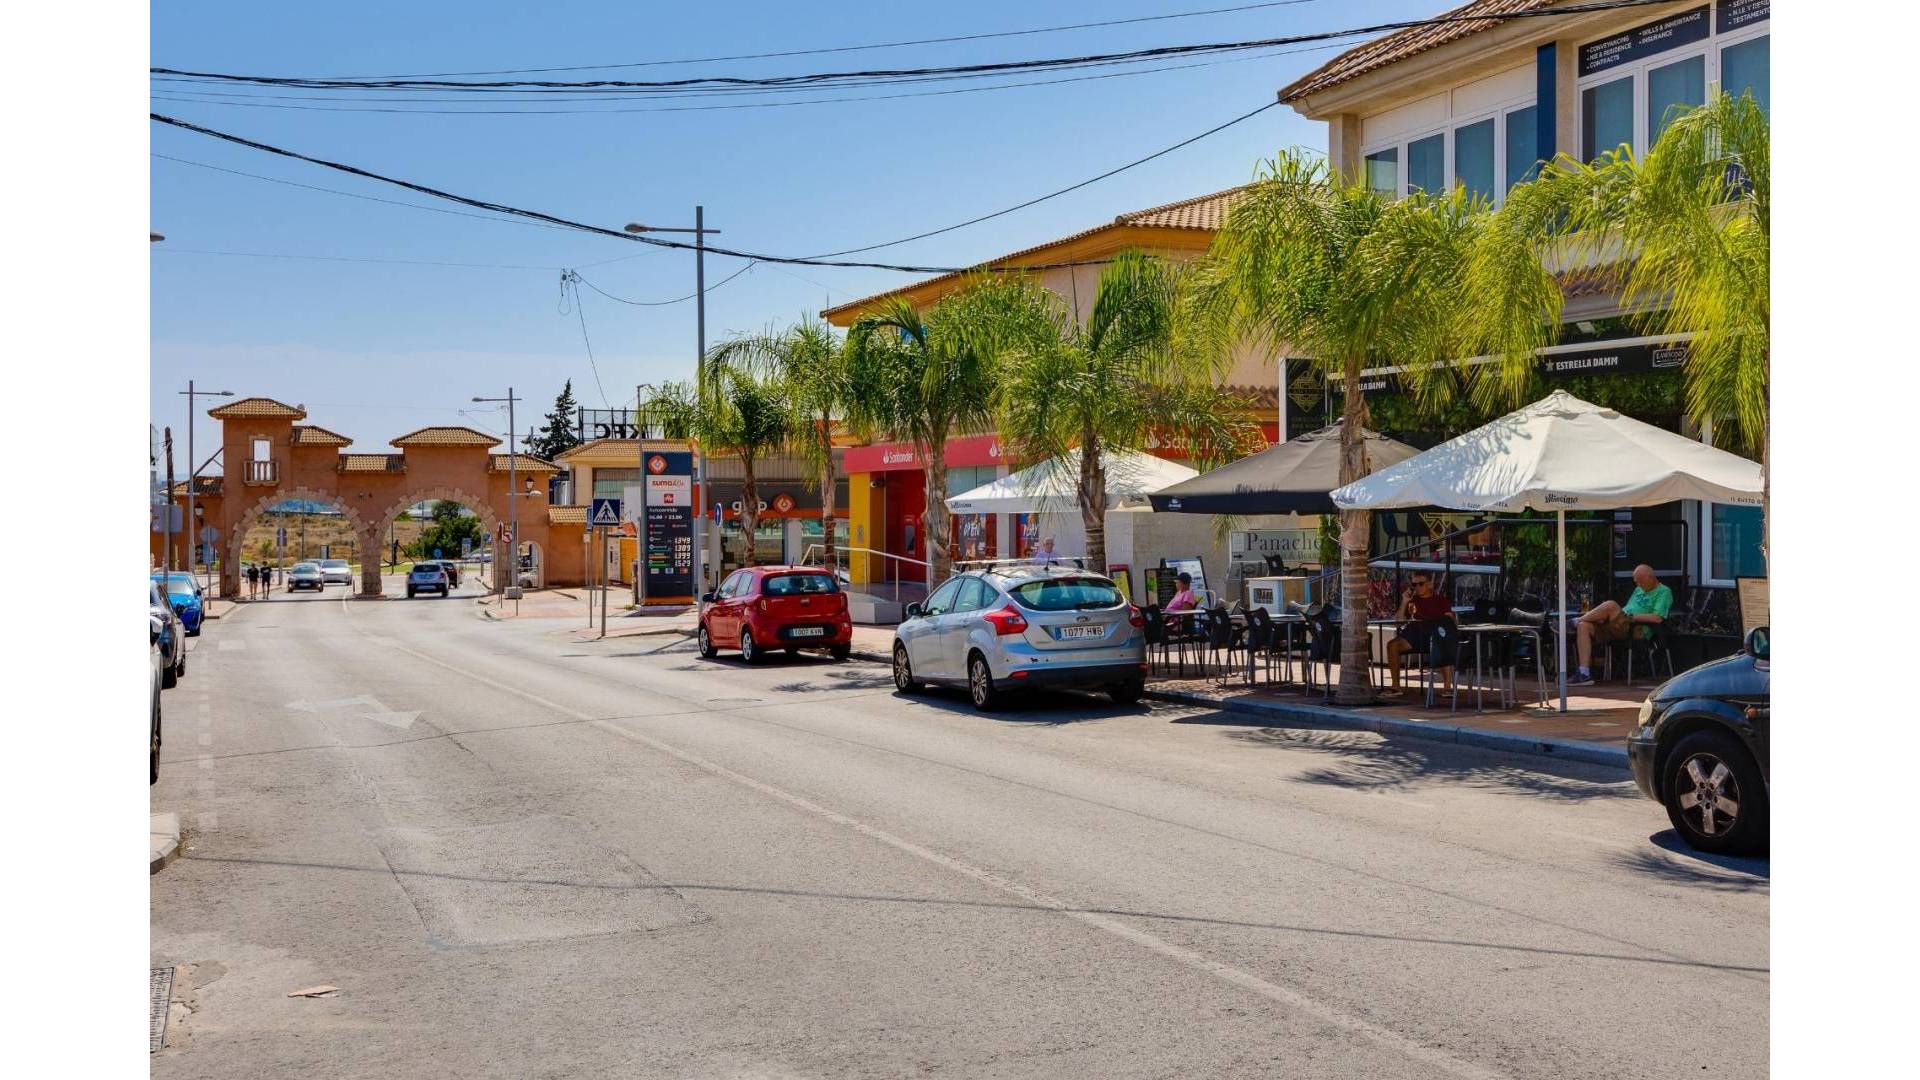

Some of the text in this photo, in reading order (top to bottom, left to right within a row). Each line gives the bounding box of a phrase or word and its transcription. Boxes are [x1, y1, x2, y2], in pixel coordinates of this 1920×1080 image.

[1589, 35, 1630, 53] CONVEYANCING
[1641, 30, 1673, 45] INSURANCE
[1603, 42, 1632, 57] RESIDENCE
[1589, 55, 1620, 69] CONTRACTS
[1556, 356, 1619, 371] ESTRELLA DAMM
[1368, 381, 1387, 390] DAMM
[889, 452, 914, 463] Santander
[732, 500, 768, 516] gp
[1247, 531, 1321, 551] Panache
[1063, 627, 1084, 637] 1077
